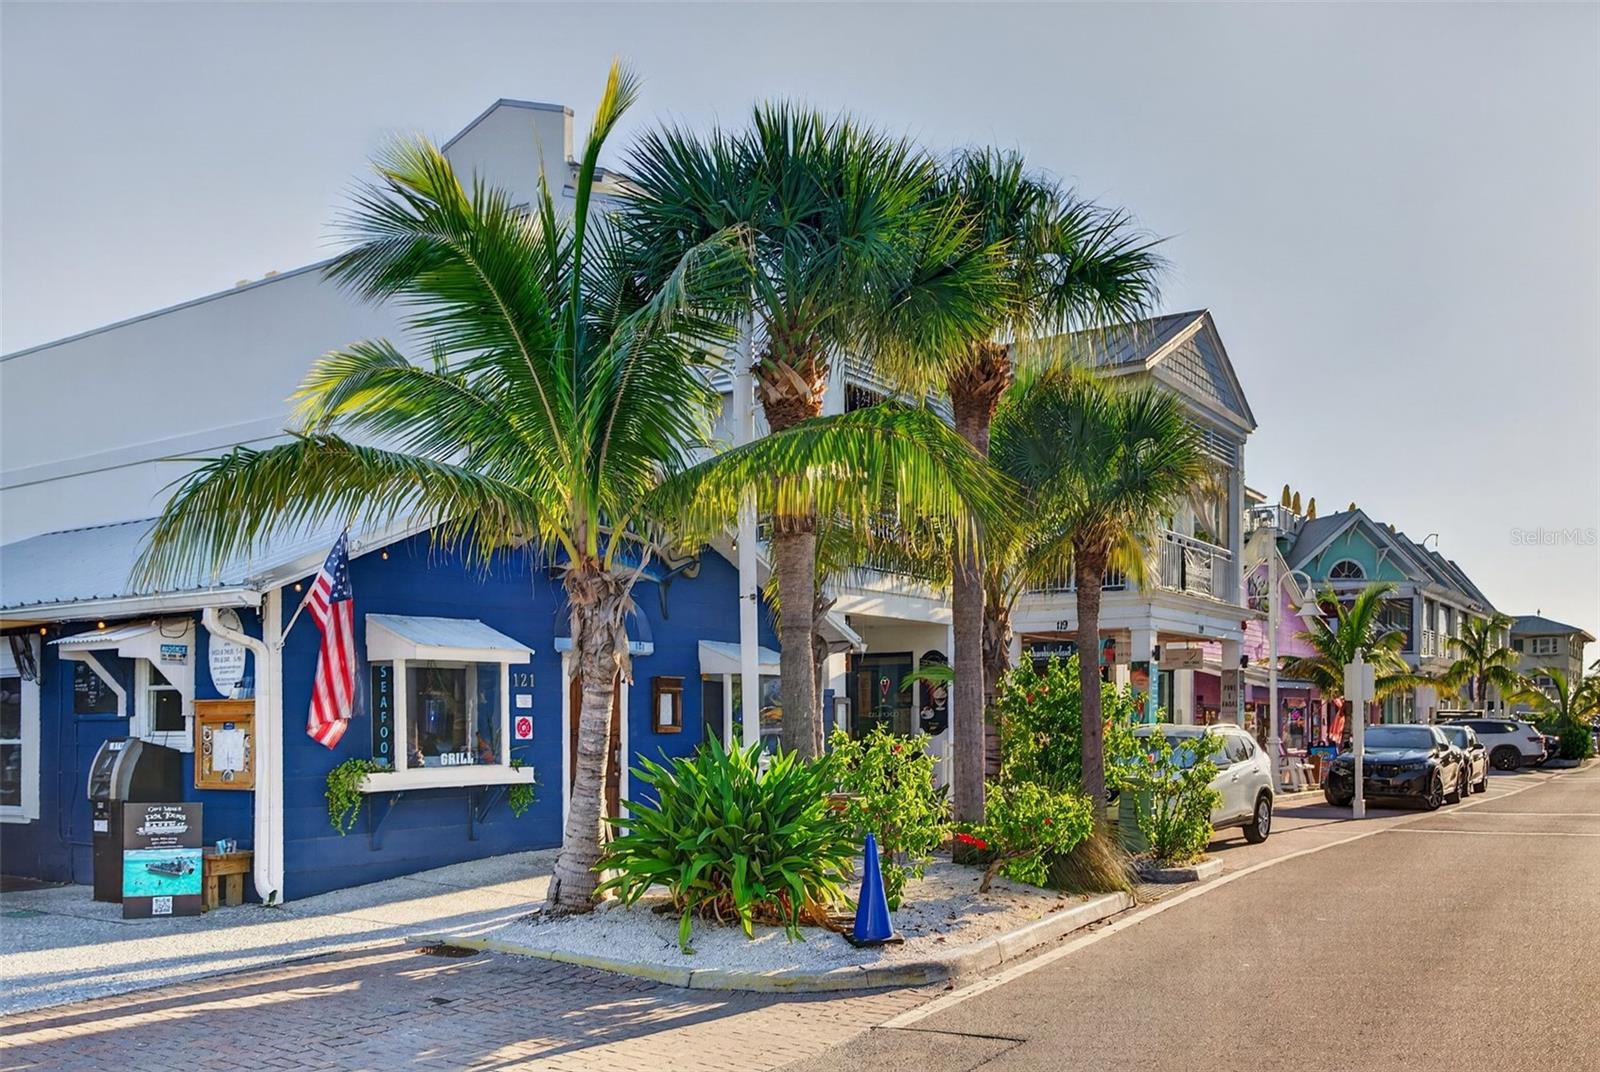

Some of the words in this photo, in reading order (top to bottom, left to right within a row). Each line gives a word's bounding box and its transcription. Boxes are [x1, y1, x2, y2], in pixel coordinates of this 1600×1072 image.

[1056, 620, 1068, 631] 119
[513, 673, 535, 688] 121
[440, 752, 474, 766] GRILL
